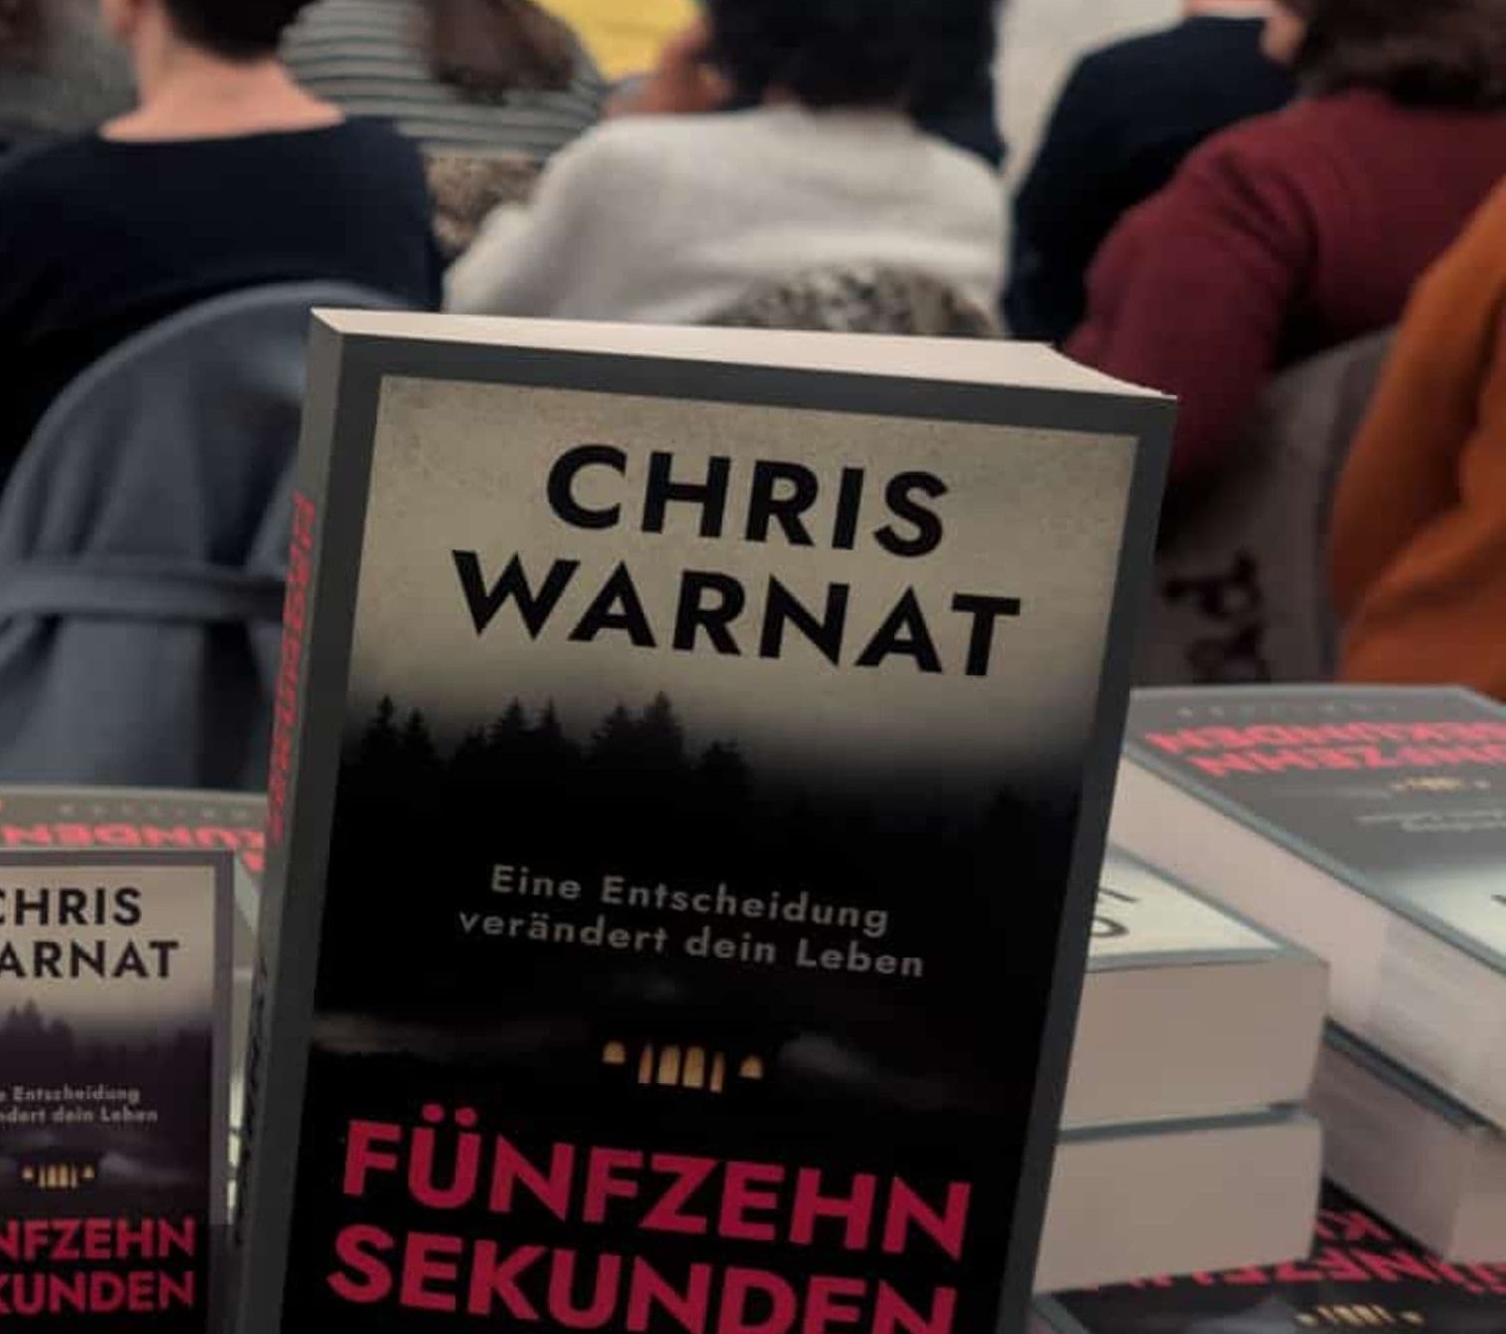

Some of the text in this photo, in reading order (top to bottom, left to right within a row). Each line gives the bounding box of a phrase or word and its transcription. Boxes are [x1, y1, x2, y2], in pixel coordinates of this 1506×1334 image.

[547, 444, 950, 557] CHRIS
[451, 549, 1022, 677] WARNAT
[490, 863, 890, 937] Eine Entscheidung
[457, 908, 926, 979] verändert dein Leben
[13, 1084, 141, 1105] Entscheidung
[51, 1105, 94, 1124] dein
[99, 1106, 158, 1124] Leben
[342, 1103, 973, 1262] FÜNFZEHN
